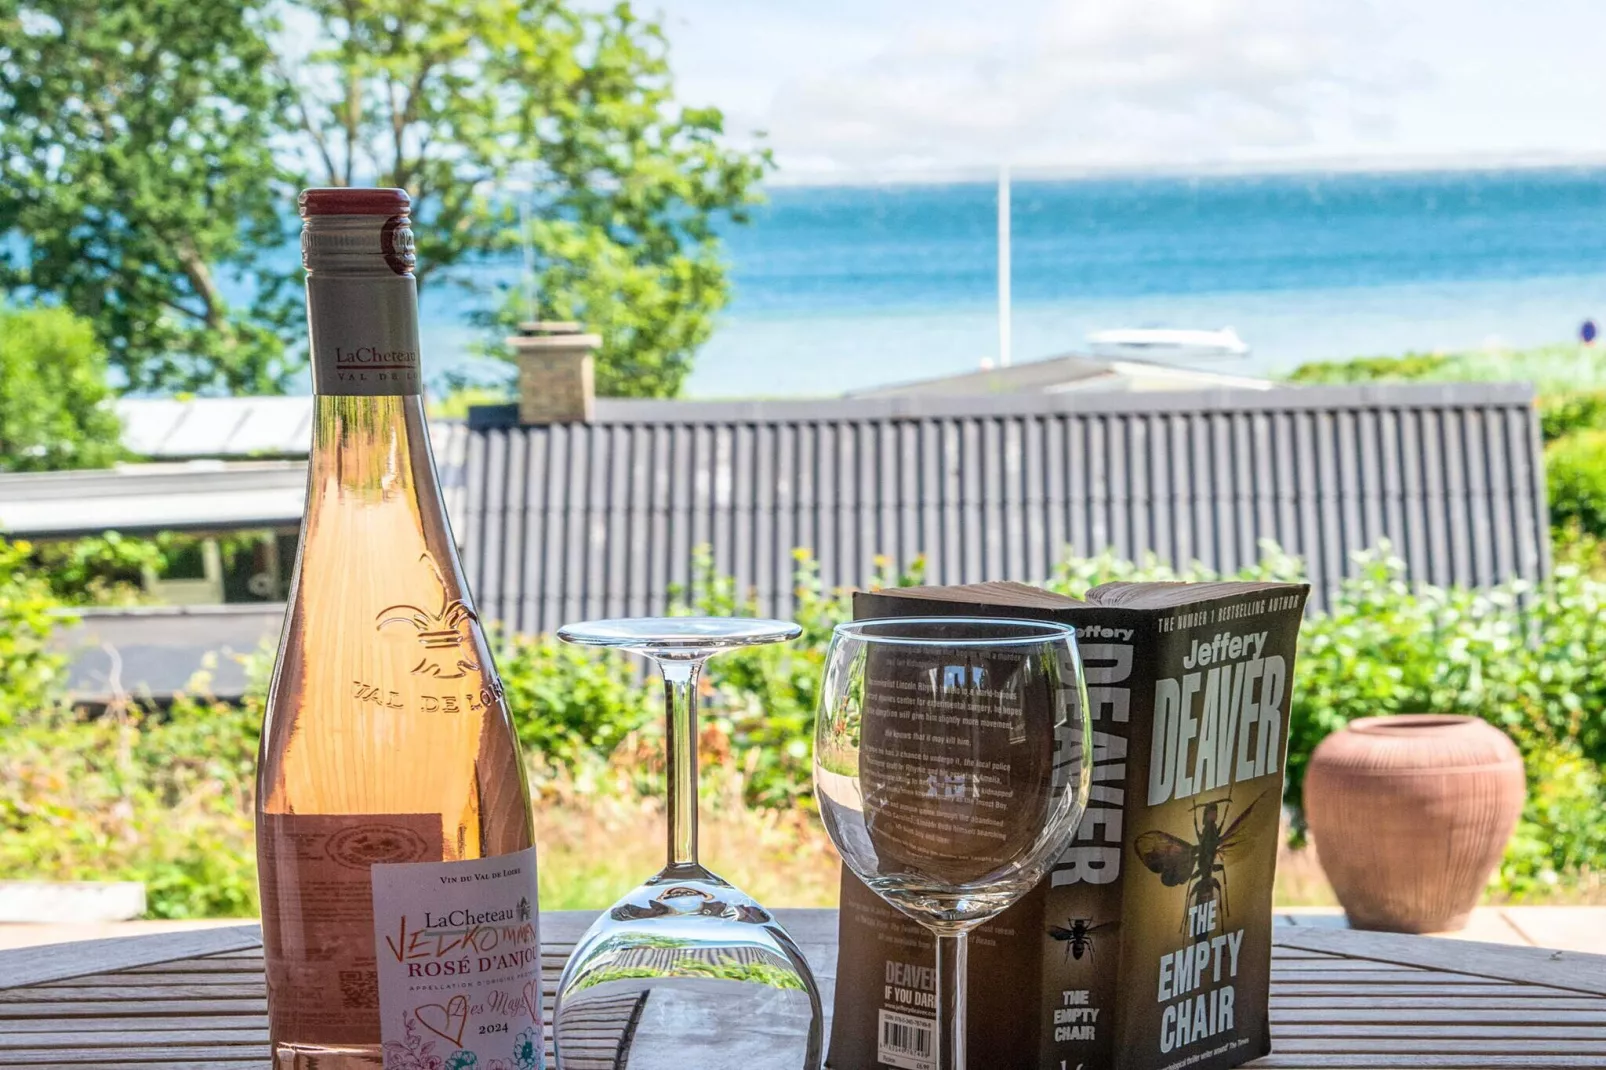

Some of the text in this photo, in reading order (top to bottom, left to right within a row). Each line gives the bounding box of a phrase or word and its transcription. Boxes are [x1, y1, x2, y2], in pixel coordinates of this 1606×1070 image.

[338, 373, 367, 381] VAL
[1158, 594, 1300, 633] THE NUMBER 1 BESTSELLING AUTHOR
[1075, 625, 1135, 642] effery
[1183, 631, 1269, 669] Jeffery
[421, 695, 460, 713] DE
[1002, 705, 1023, 717] hopes
[962, 717, 980, 726] more
[931, 735, 945, 744] may
[1147, 655, 1286, 807] DEAVER
[963, 758, 975, 767] the
[975, 759, 991, 769] local
[991, 762, 1011, 773] police
[1051, 644, 1134, 888] DEAVER
[440, 876, 458, 885] VIN
[460, 875, 472, 883] DU
[474, 872, 490, 881] VAL
[491, 871, 502, 879] DE
[425, 908, 514, 929] LaCheteau
[1188, 899, 1217, 938] THE
[407, 955, 471, 978] ROSÉ
[1157, 928, 1244, 1003] EMPTY
[410, 982, 473, 992] APPELLATION
[884, 985, 937, 1009] IF YOU DAR
[1063, 990, 1090, 1006] THE
[1053, 1008, 1101, 1025] EMPTY
[1160, 985, 1235, 1054] CHAIR
[479, 1022, 509, 1035] 2024
[1054, 1026, 1096, 1043] CHAIR
